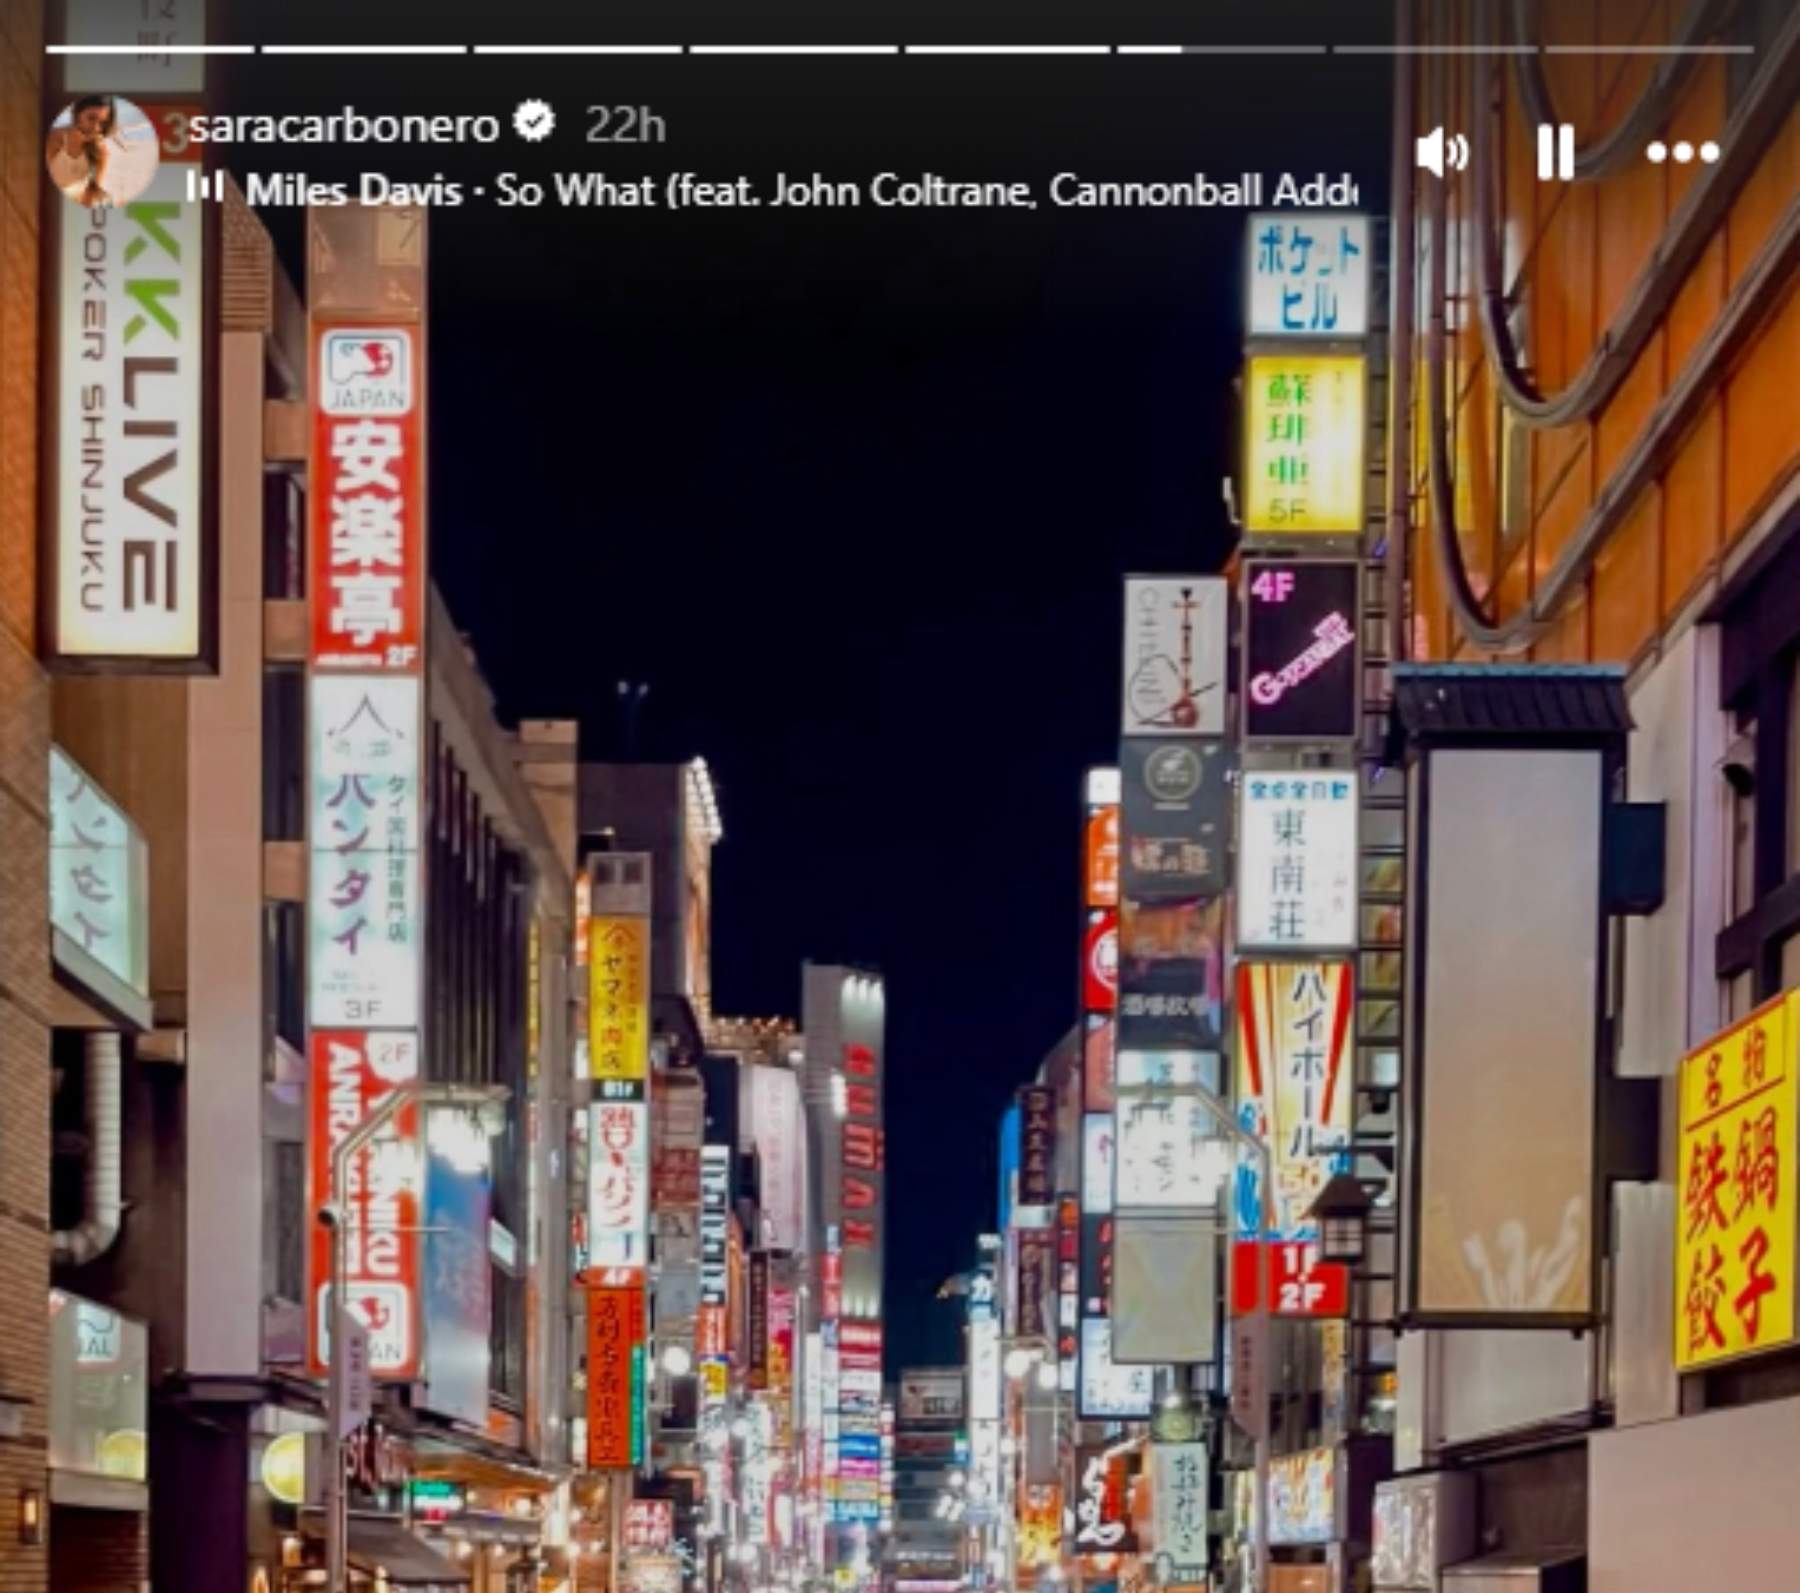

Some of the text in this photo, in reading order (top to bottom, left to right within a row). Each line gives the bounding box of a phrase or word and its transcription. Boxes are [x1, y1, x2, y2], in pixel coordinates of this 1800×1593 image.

[331, 387, 405, 408] JAPAN
[80, 384, 106, 612] SHINJUKU
[1268, 498, 1307, 523] 5F
[329, 419, 404, 647] 安楽亭
[1251, 571, 1295, 602] 4F
[387, 645, 416, 667] 2F
[345, 999, 383, 1020] 3F
[379, 1042, 410, 1064] 2F
[1289, 972, 1327, 1158] ハイボール
[1279, 1282, 1327, 1311] 2F
